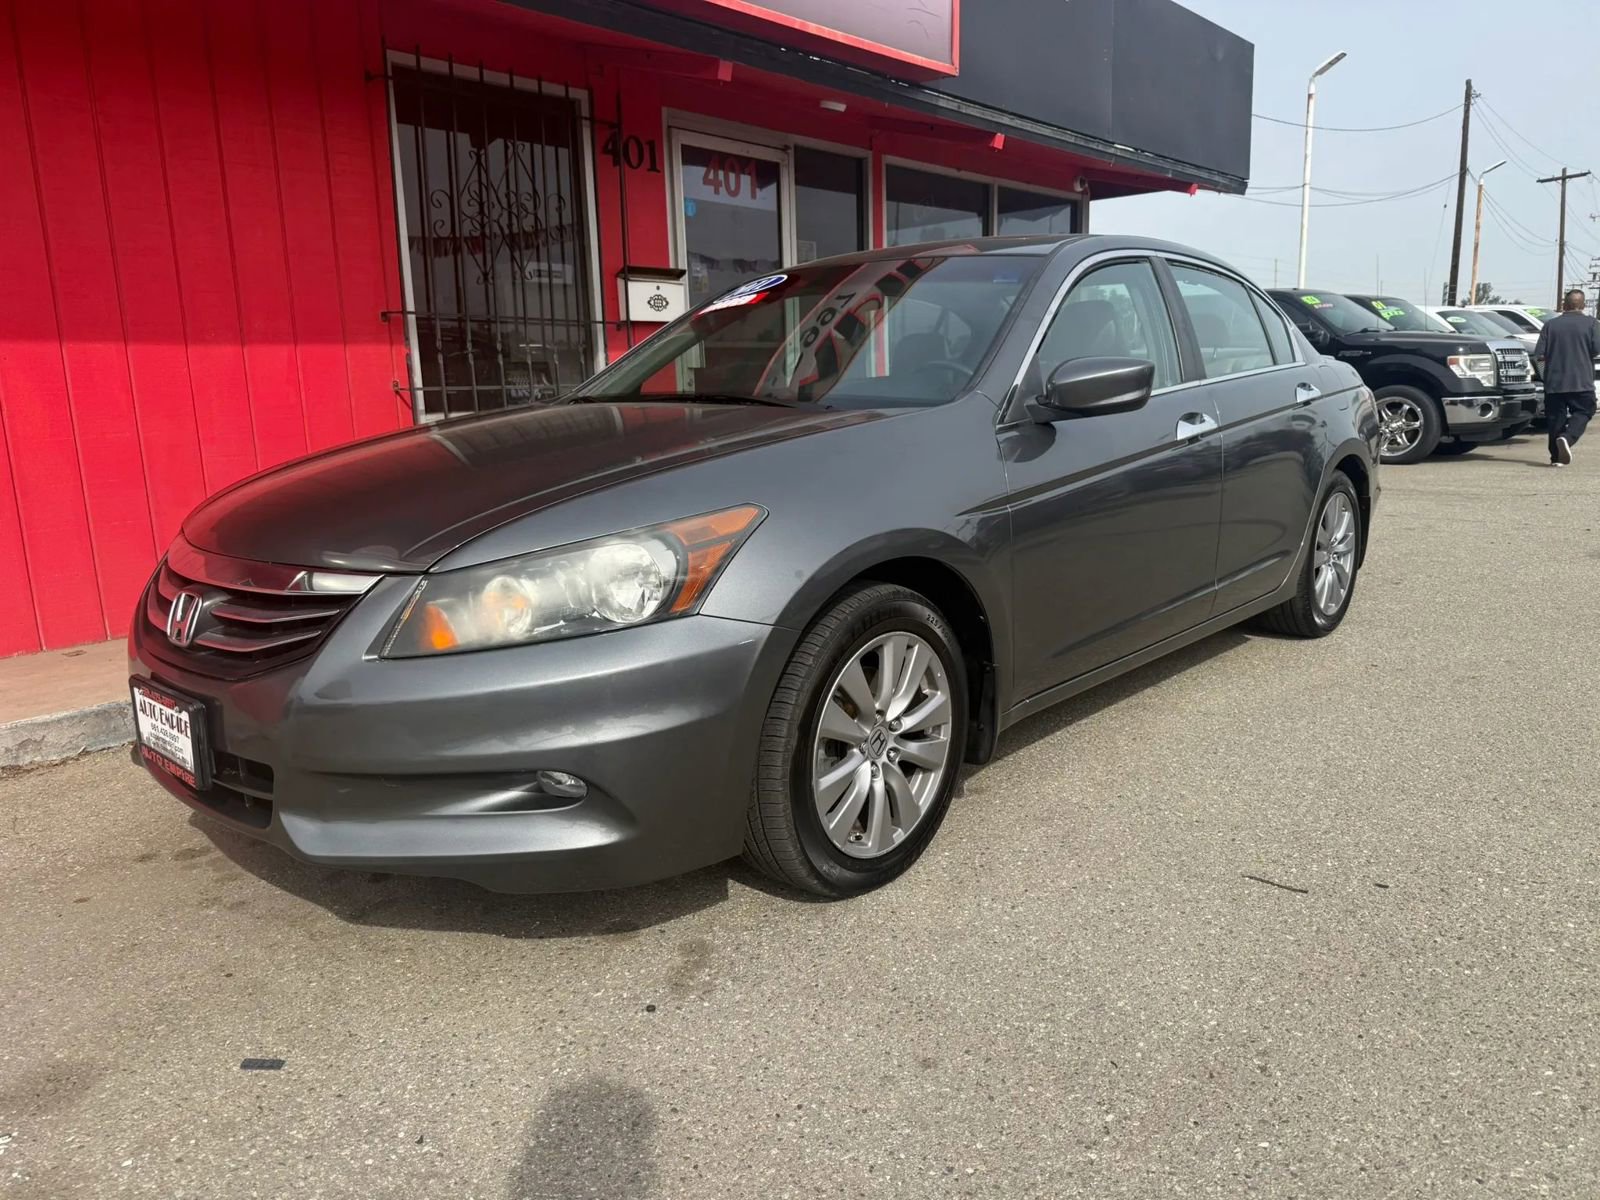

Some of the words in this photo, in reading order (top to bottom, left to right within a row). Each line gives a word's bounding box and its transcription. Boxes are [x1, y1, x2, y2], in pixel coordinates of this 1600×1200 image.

[602, 131, 661, 173] 401
[702, 155, 759, 200] 401
[139, 698, 159, 722] AUTO
[159, 707, 190, 739] EMPIRE
[141, 745, 164, 766] AUTO
[164, 757, 196, 787] EMPIRE
